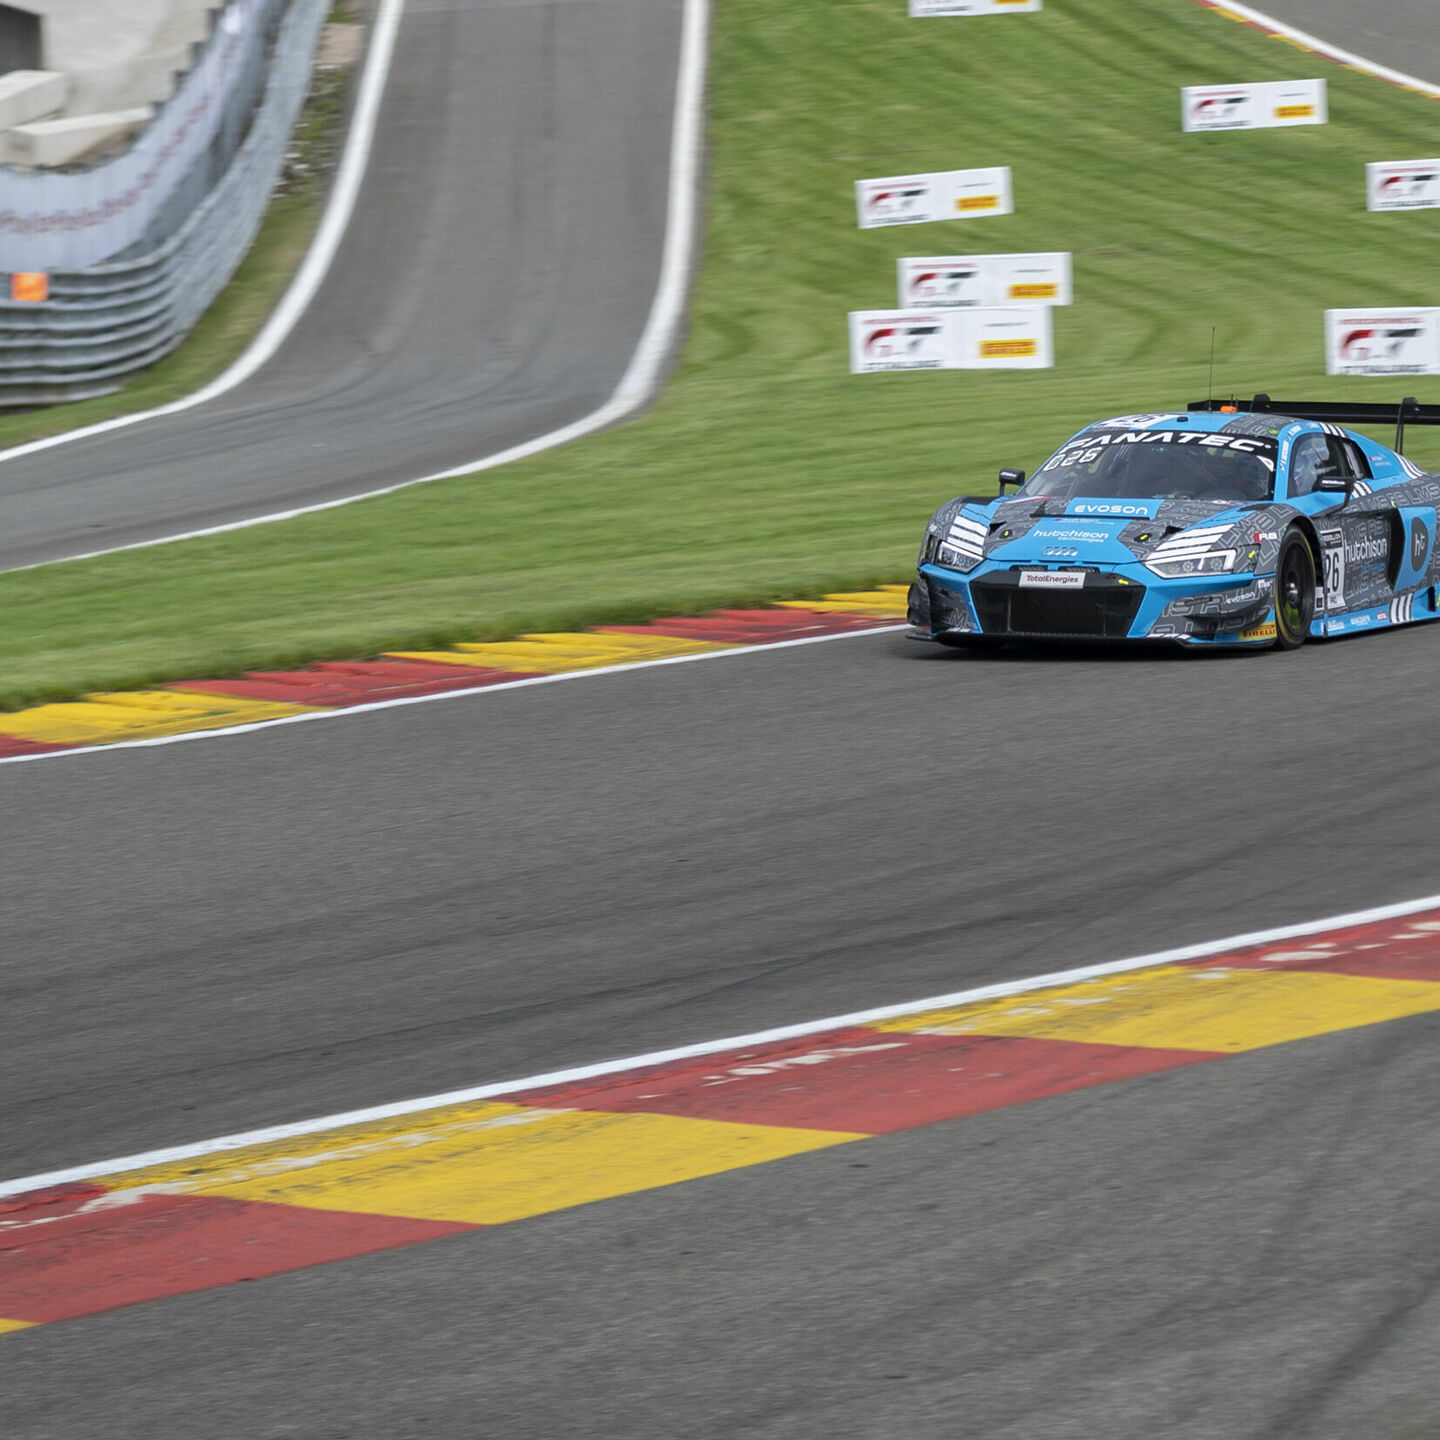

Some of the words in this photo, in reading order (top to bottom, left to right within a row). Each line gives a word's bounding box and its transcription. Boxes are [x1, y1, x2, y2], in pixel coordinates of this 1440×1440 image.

[1062, 430, 1266, 453] FANATEC
[1033, 529, 1109, 539] hutchison
[1344, 535, 1388, 563] hutchison
[1026, 574, 1078, 584] TotalEnergies
[1325, 551, 1340, 593] 26
[1242, 624, 1276, 638] PIRELLI
